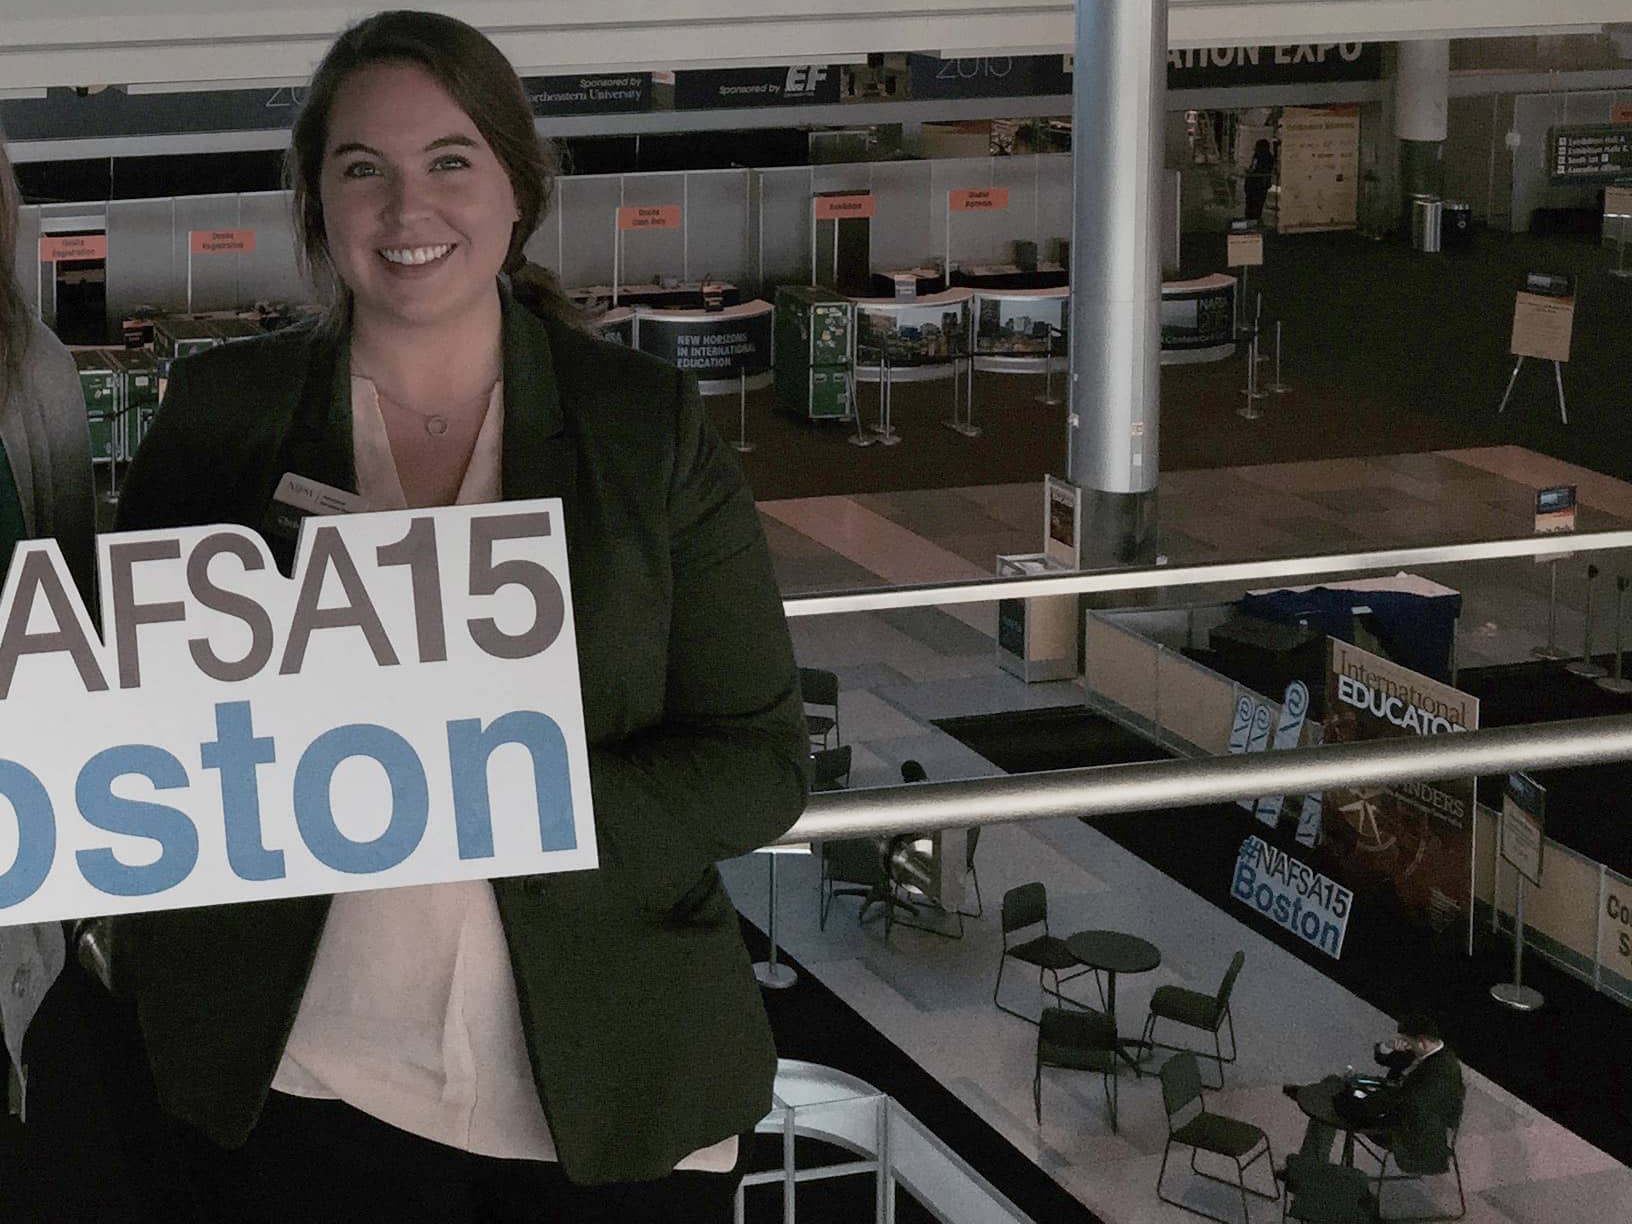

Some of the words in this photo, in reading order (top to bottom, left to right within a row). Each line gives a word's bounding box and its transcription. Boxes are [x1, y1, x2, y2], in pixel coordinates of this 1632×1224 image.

[527, 90, 587, 104] ortheastern
[590, 88, 642, 101] University
[579, 78, 629, 89] Sponsored
[630, 77, 642, 87] by
[677, 357, 732, 369] EDUCATION
[1341, 650, 1466, 727] International
[1239, 834, 1349, 919] #NAFSA15
[1233, 864, 1341, 954] Boston
